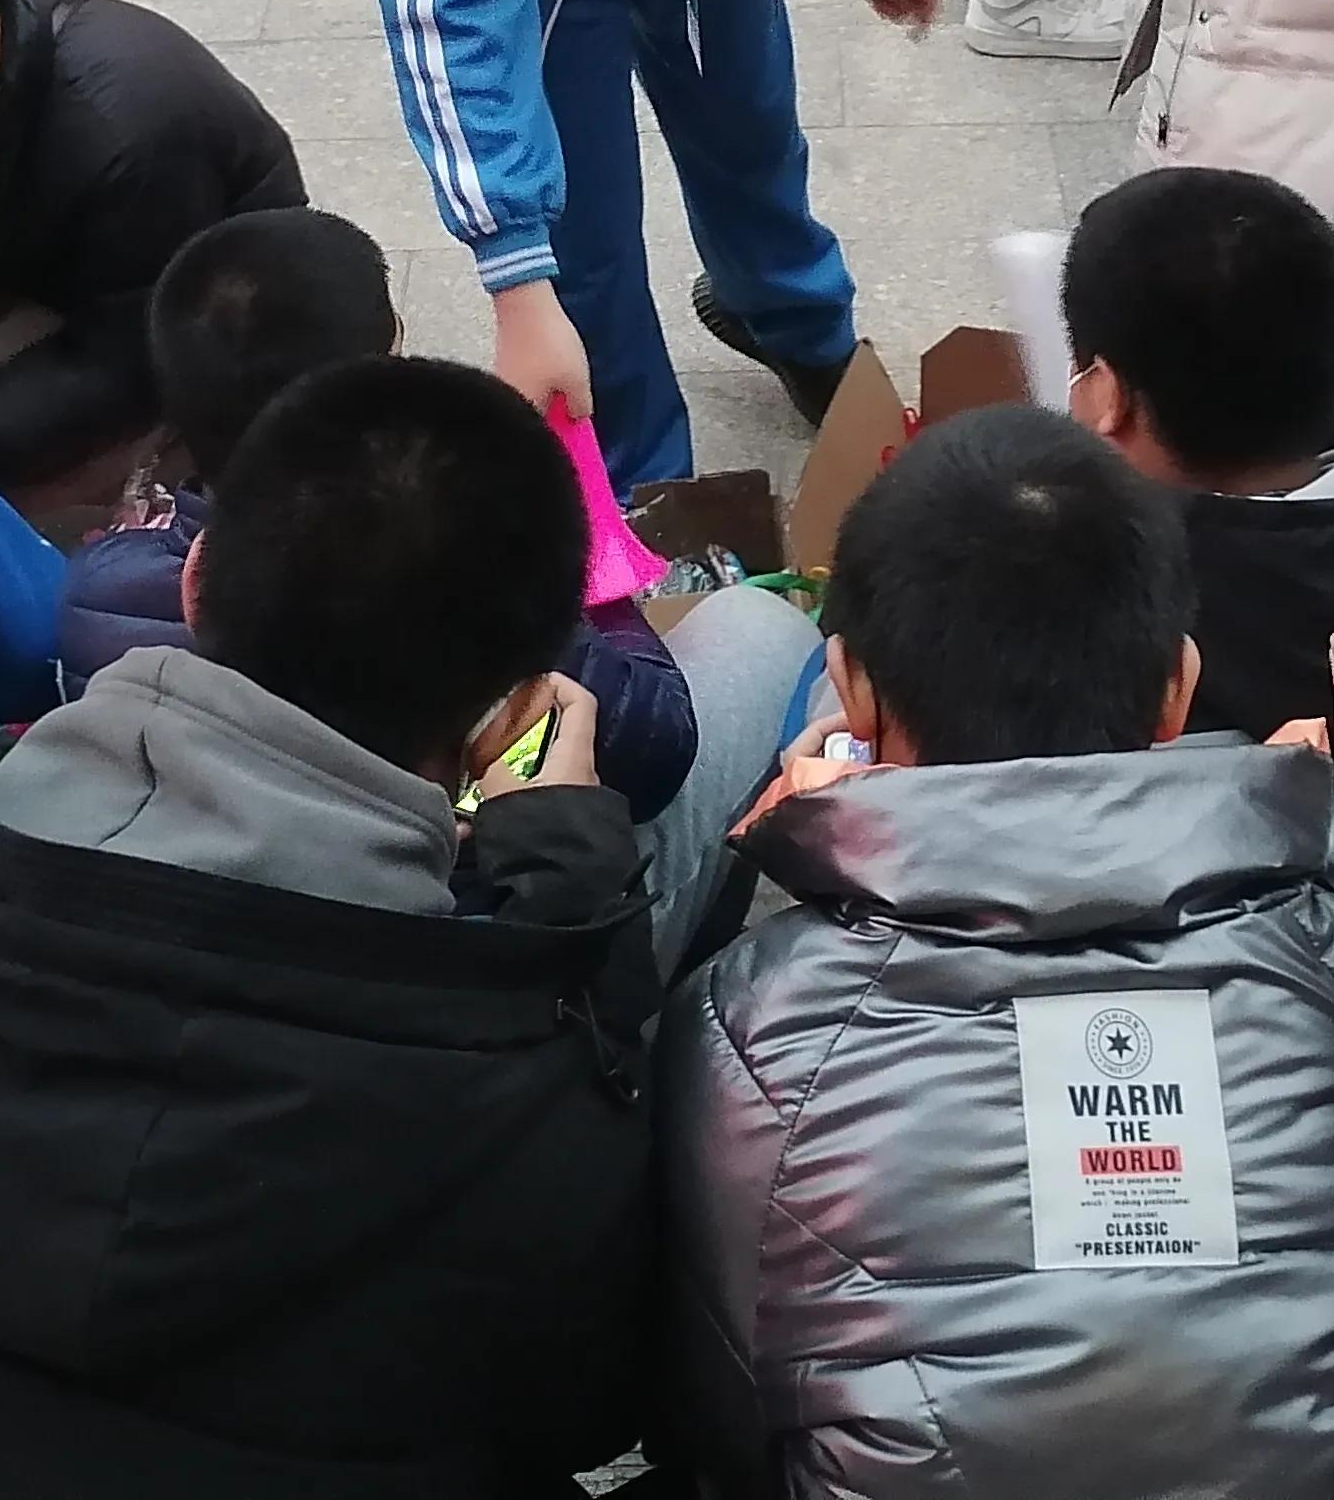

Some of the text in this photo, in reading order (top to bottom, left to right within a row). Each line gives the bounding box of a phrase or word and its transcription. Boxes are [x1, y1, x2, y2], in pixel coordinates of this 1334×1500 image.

[1093, 1011, 1140, 1030] FASHION
[1067, 1083, 1184, 1117] WARM
[1105, 1120, 1153, 1143] THE
[1087, 1148, 1177, 1173] WORLD
[1105, 1221, 1169, 1237] CLASSIC
